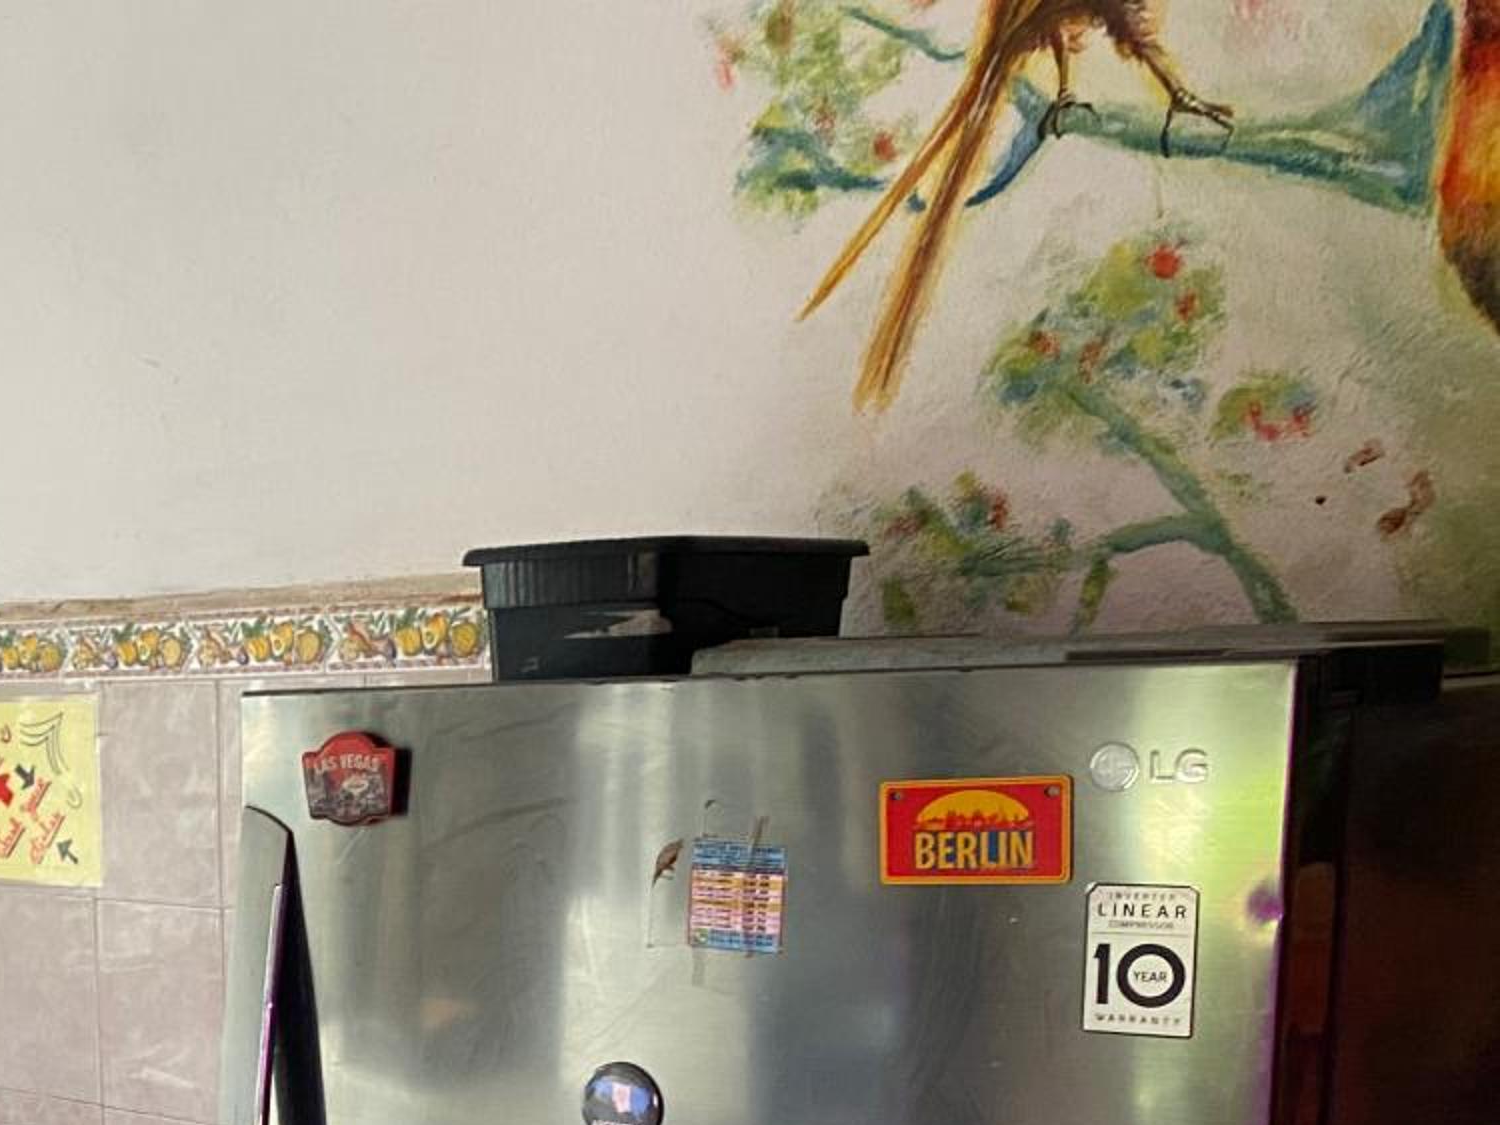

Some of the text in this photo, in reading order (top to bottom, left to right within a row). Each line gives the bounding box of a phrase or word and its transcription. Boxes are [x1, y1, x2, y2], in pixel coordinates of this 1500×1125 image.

[1149, 749, 1208, 784] LG
[915, 831, 1033, 869] BERLIN
[1097, 902, 1188, 919] LINEAR
[1093, 943, 1187, 1009] 10
[1133, 971, 1168, 982] YEAR
